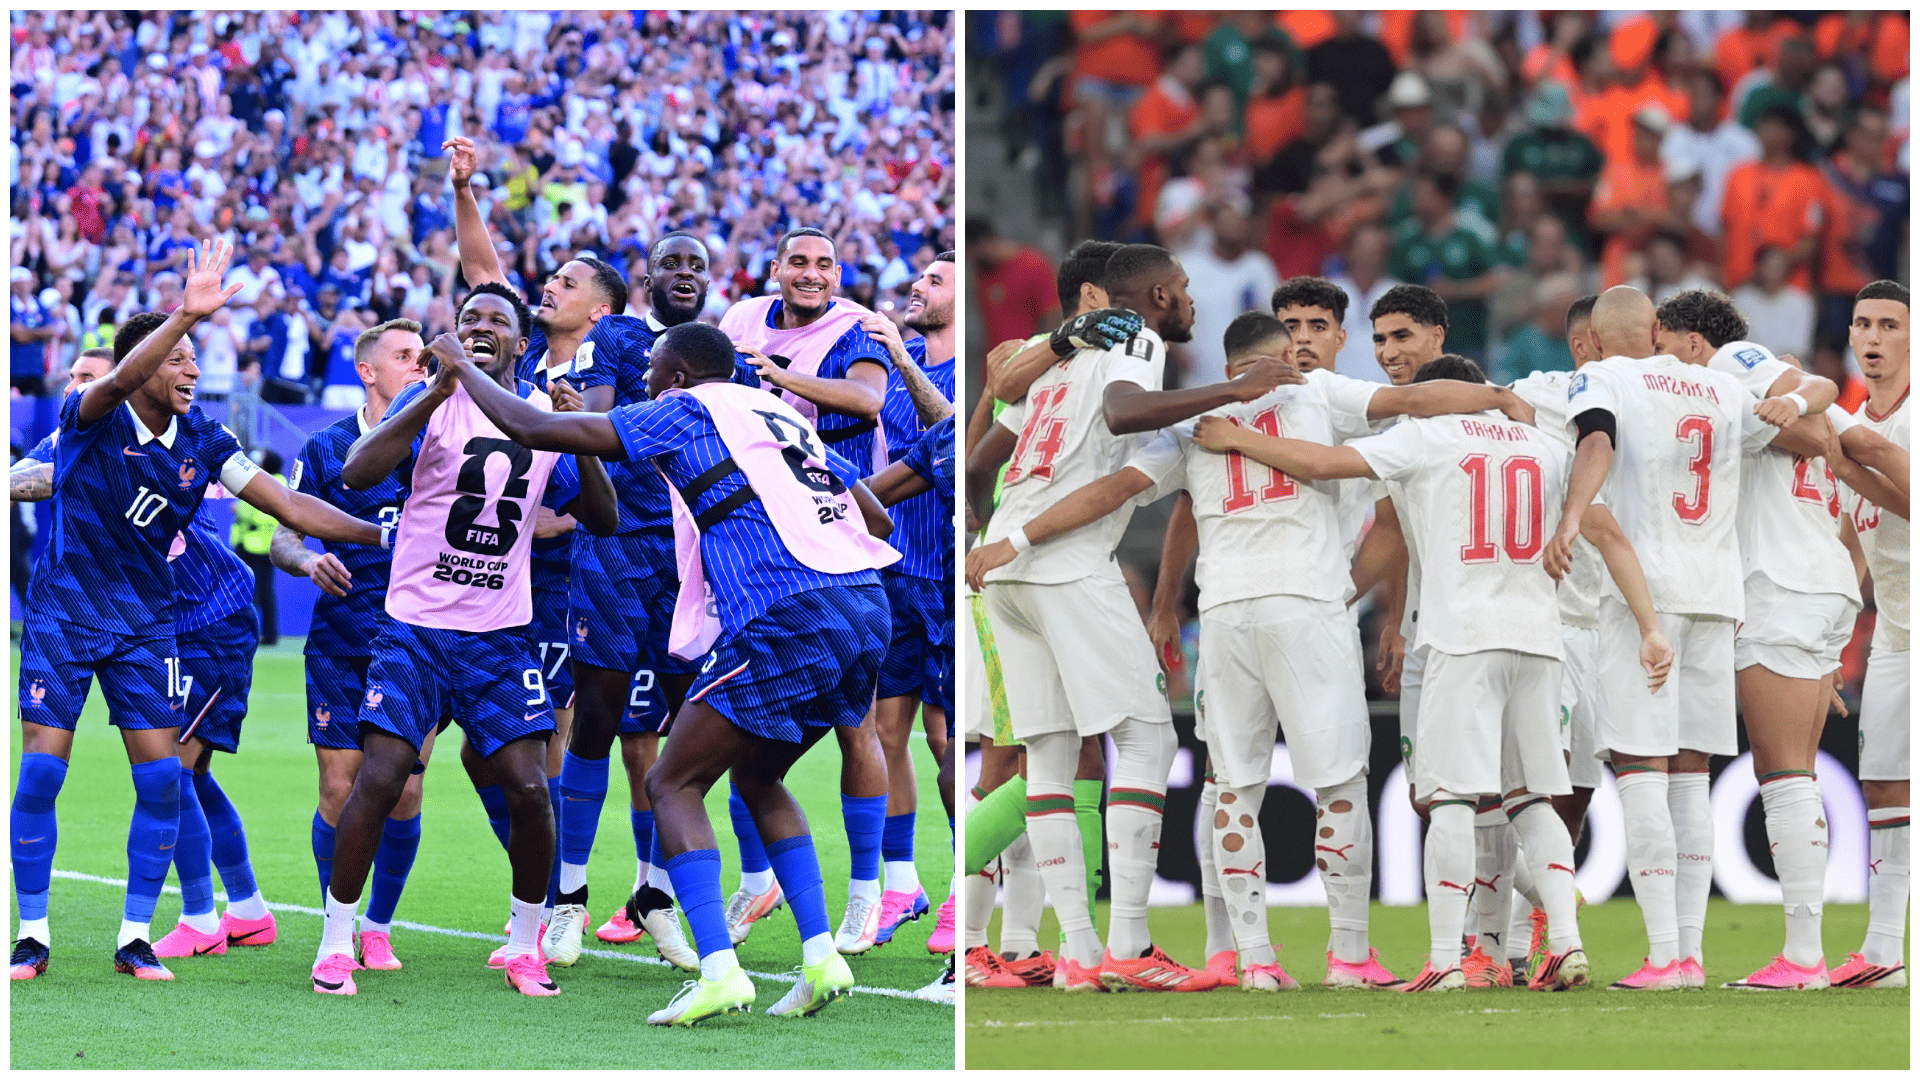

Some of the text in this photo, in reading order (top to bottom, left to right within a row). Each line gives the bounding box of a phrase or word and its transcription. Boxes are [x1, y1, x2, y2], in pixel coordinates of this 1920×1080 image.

[1003, 382, 1071, 483] 14
[1672, 414, 1714, 526] 3
[125, 486, 168, 527] 10
[1459, 453, 1545, 565] 10
[466, 529, 499, 546] FIFA
[432, 563, 505, 590] 2026
[439, 552, 508, 571] WORLD CUP
[538, 641, 569, 680] 17
[522, 668, 546, 706] 9
[630, 669, 655, 706] 2
